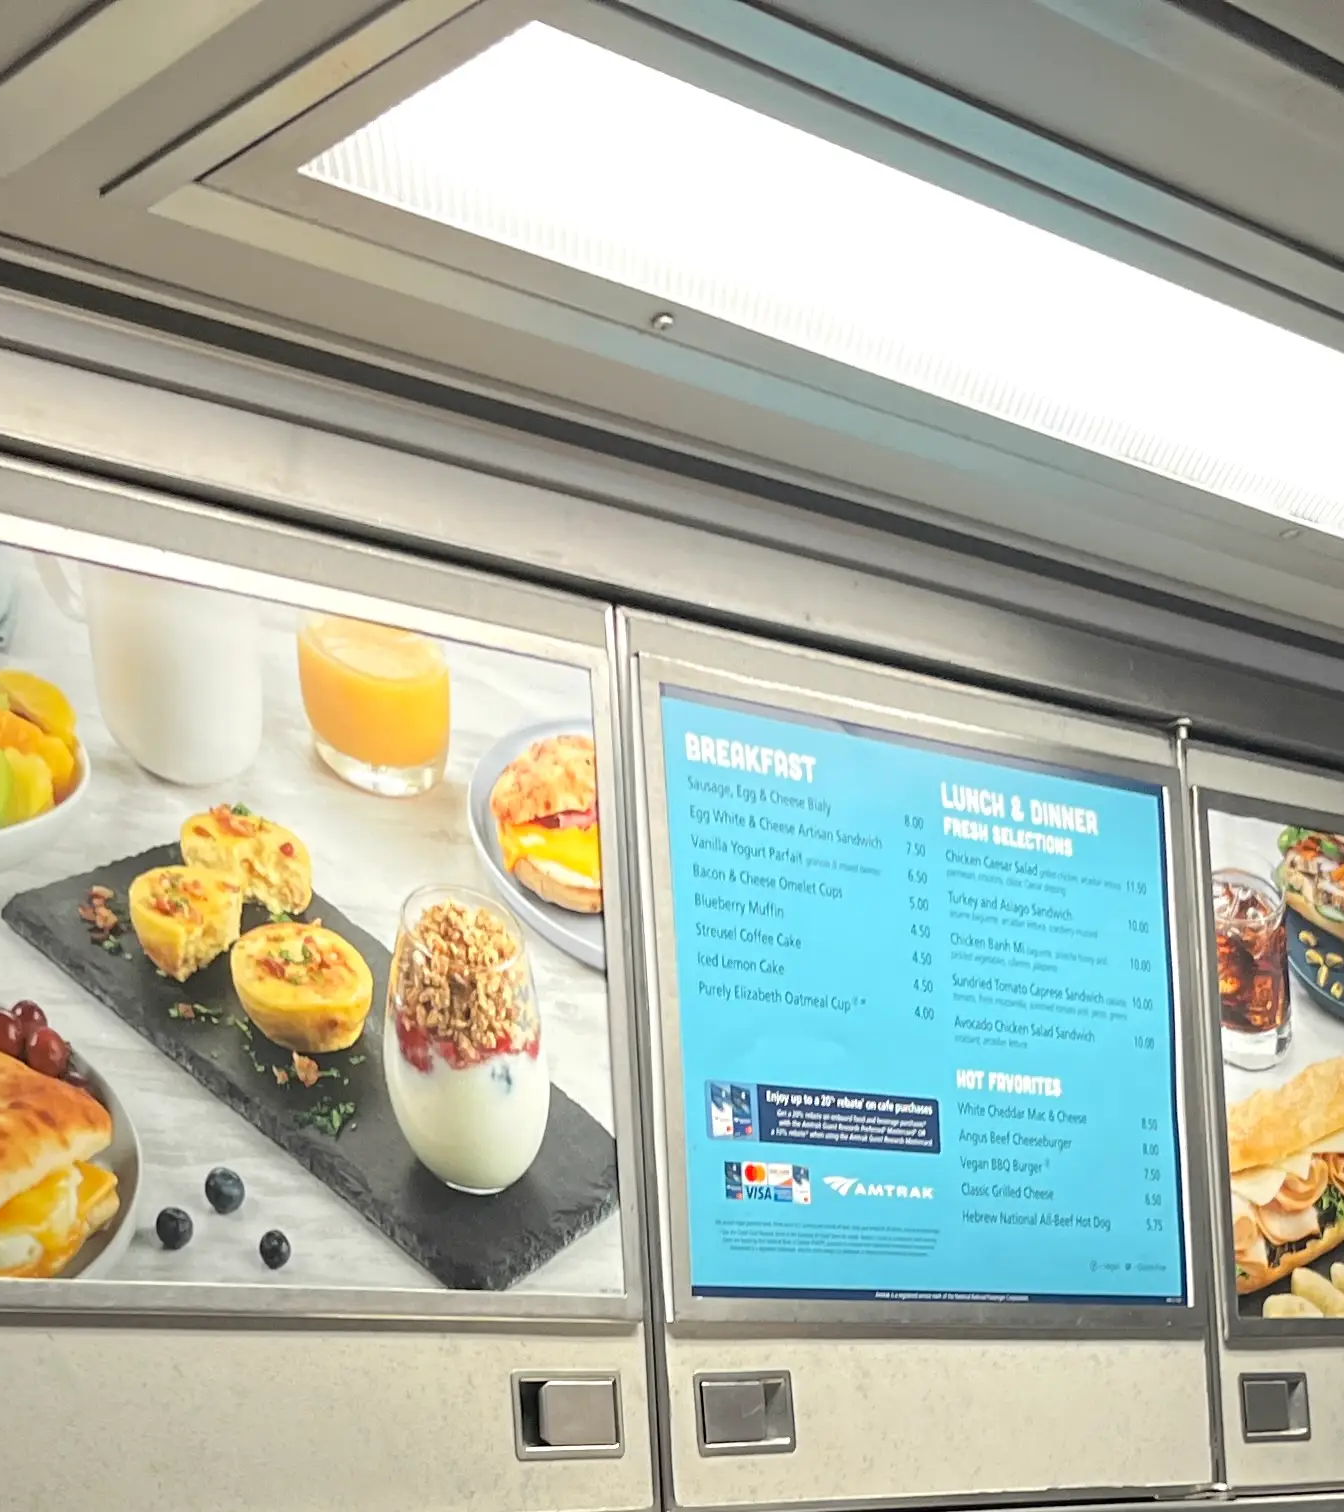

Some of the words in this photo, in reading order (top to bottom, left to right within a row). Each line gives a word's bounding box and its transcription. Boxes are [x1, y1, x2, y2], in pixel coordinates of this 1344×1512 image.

[684, 731, 817, 784] BREAKFAST
[687, 775, 735, 799] Sausage,
[736, 783, 757, 803] Egg
[759, 788, 767, 801] &
[769, 790, 805, 810] Cheese
[940, 782, 1005, 820] LUNCH
[1010, 794, 1025, 823] &
[1030, 798, 1100, 837] DINNER
[689, 804, 711, 824] Egg
[713, 808, 746, 828] White
[748, 816, 757, 828] &
[759, 816, 795, 836] Cheese
[798, 823, 833, 843] Artisan
[836, 830, 883, 850] Sandwich
[904, 814, 924, 831] 8.00
[690, 833, 728, 852] Vanilla
[731, 840, 767, 861] Yogurt
[768, 847, 804, 866] Parfait
[905, 841, 926, 858] 7.50
[943, 816, 989, 843] FRESH
[992, 824, 1073, 858] SELECTIONS
[945, 849, 982, 868] Chicken
[983, 856, 1013, 873] Caesar
[1014, 860, 1039, 877] Salad
[692, 863, 726, 881] Bacon
[728, 870, 737, 882] &
[739, 870, 776, 889] Cheese
[778, 876, 817, 895] Omelet
[819, 882, 844, 901] Cups
[907, 869, 928, 885] 6.50
[694, 892, 746, 918] Blueberry
[748, 900, 785, 919] Muffin
[908, 896, 930, 912] 5.00
[947, 890, 979, 909] Turkey
[980, 895, 998, 911] and
[1031, 903, 1073, 921] Sandwich
[695, 921, 737, 942] Streusel
[739, 927, 774, 946] Coffee
[776, 932, 802, 950] Cake
[910, 923, 931, 939] 4.50
[950, 932, 986, 950] Chicken
[987, 936, 1011, 952] Banh
[697, 951, 719, 967] Iced
[721, 955, 757, 972] Lemon
[759, 959, 785, 976] Cake
[912, 950, 933, 966] 4.50
[698, 980, 732, 1001] Purely
[734, 984, 782, 1005] Elizabeth
[784, 991, 829, 1010] Oatmeal
[831, 996, 852, 1013] Cup
[913, 978, 934, 994] 4.50
[952, 973, 993, 991] Sundried
[994, 978, 1028, 996] Tomato
[1029, 982, 1063, 1001] Caprese
[1065, 987, 1105, 1005] Sandwich
[914, 1005, 935, 1021] 4.00
[954, 1016, 993, 1033] Avocado
[995, 1019, 1029, 1036] Chicken
[1031, 1023, 1054, 1039] Salad
[1056, 1025, 1095, 1043] Sandwich
[956, 1068, 985, 1090] HOT
[988, 1072, 1062, 1098] FAVORITES
[765, 1089, 789, 1106] Enjoy
[790, 1092, 803, 1107] up
[803, 1092, 813, 1106] to
[865, 1100, 877, 1111] on
[957, 1101, 986, 1117] White
[987, 1104, 1025, 1120] Cheddar
[1056, 1111, 1088, 1125] Cheese
[958, 1129, 988, 1147] Angus
[989, 1130, 1011, 1145] Beef
[1012, 1134, 1072, 1154] Cheeseburger
[959, 1155, 990, 1174] Vegan
[1013, 1159, 1043, 1177] Burger
[746, 1186, 772, 1200] VISA
[854, 1183, 934, 1200] AMTRAK
[961, 1182, 990, 1198] Classic
[991, 1184, 1022, 1200] Grilled
[1023, 1186, 1054, 1200] Cheese
[962, 1209, 998, 1225] Hebrew
[999, 1211, 1038, 1226] National
[1075, 1215, 1092, 1229] Hot
[1093, 1216, 1111, 1232] Dog
